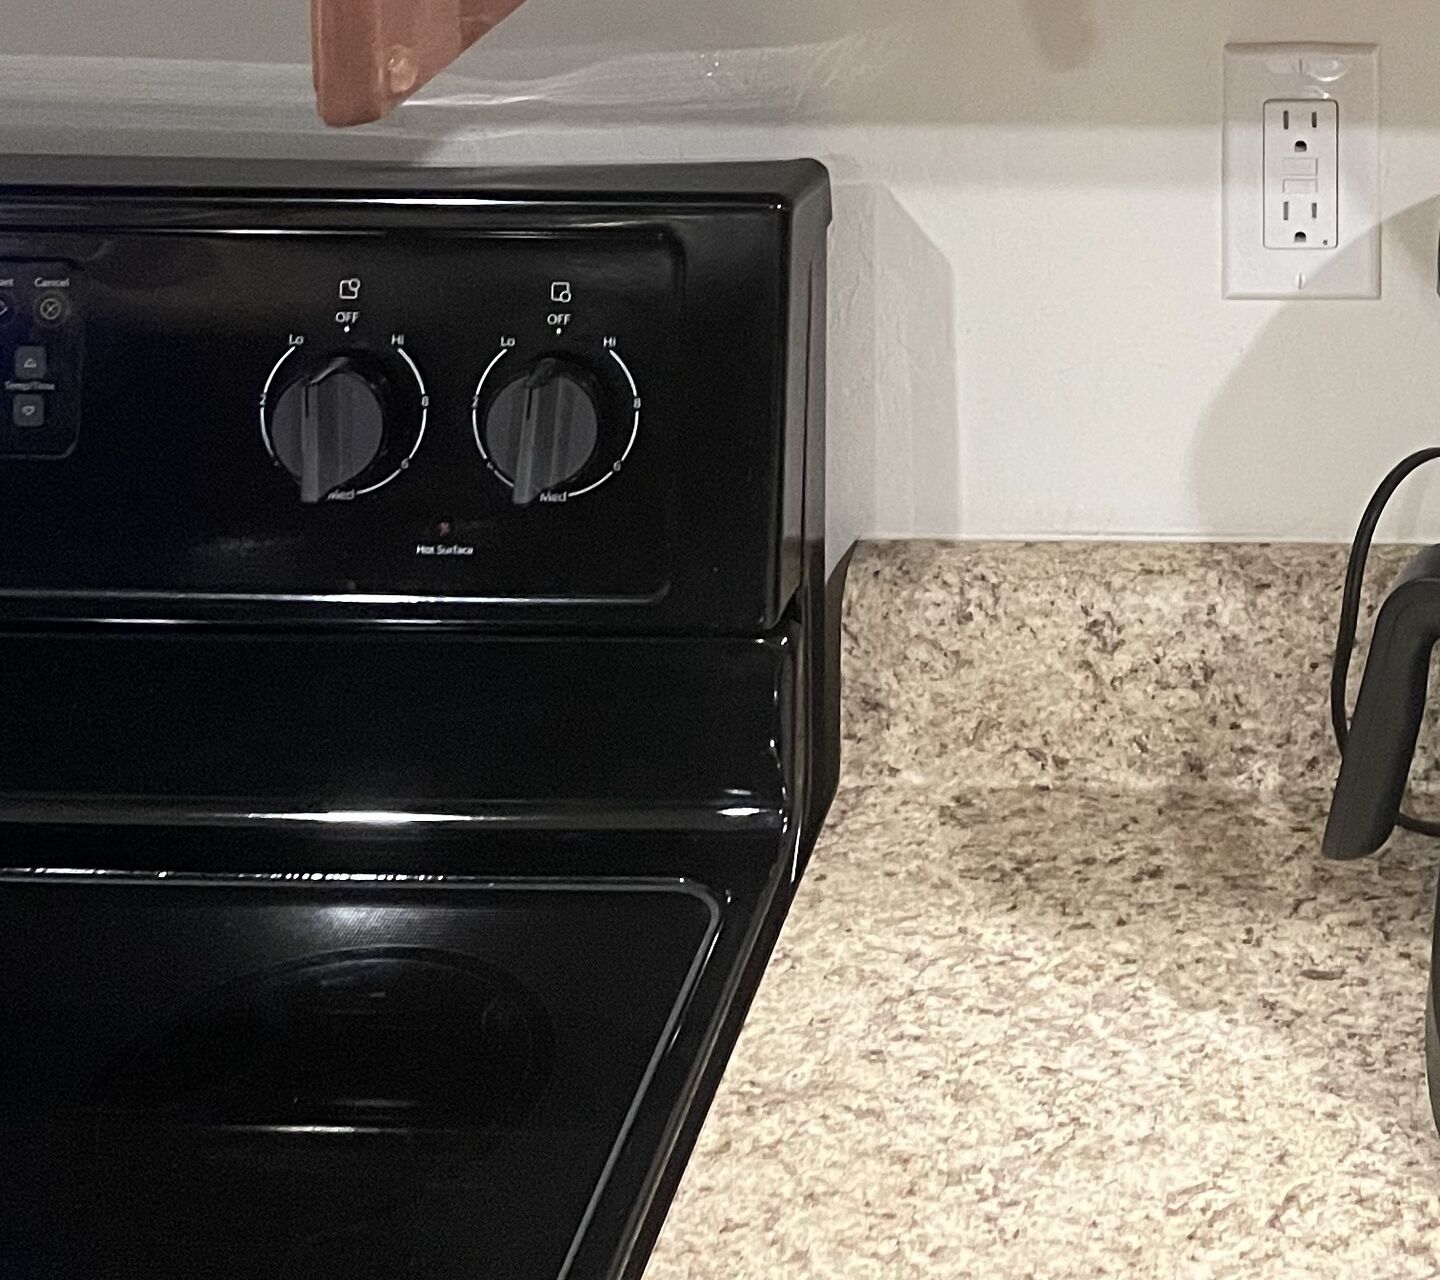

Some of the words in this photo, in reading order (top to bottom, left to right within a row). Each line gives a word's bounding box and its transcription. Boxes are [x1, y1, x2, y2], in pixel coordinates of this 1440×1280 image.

[335, 310, 360, 324] OFF
[547, 313, 573, 326] OFF
[500, 336, 516, 348] Lo
[259, 392, 268, 407] 2
[632, 396, 642, 410] 8
[612, 459, 622, 473] 6
[538, 490, 568, 503] Med
[436, 543, 474, 556] Surface
